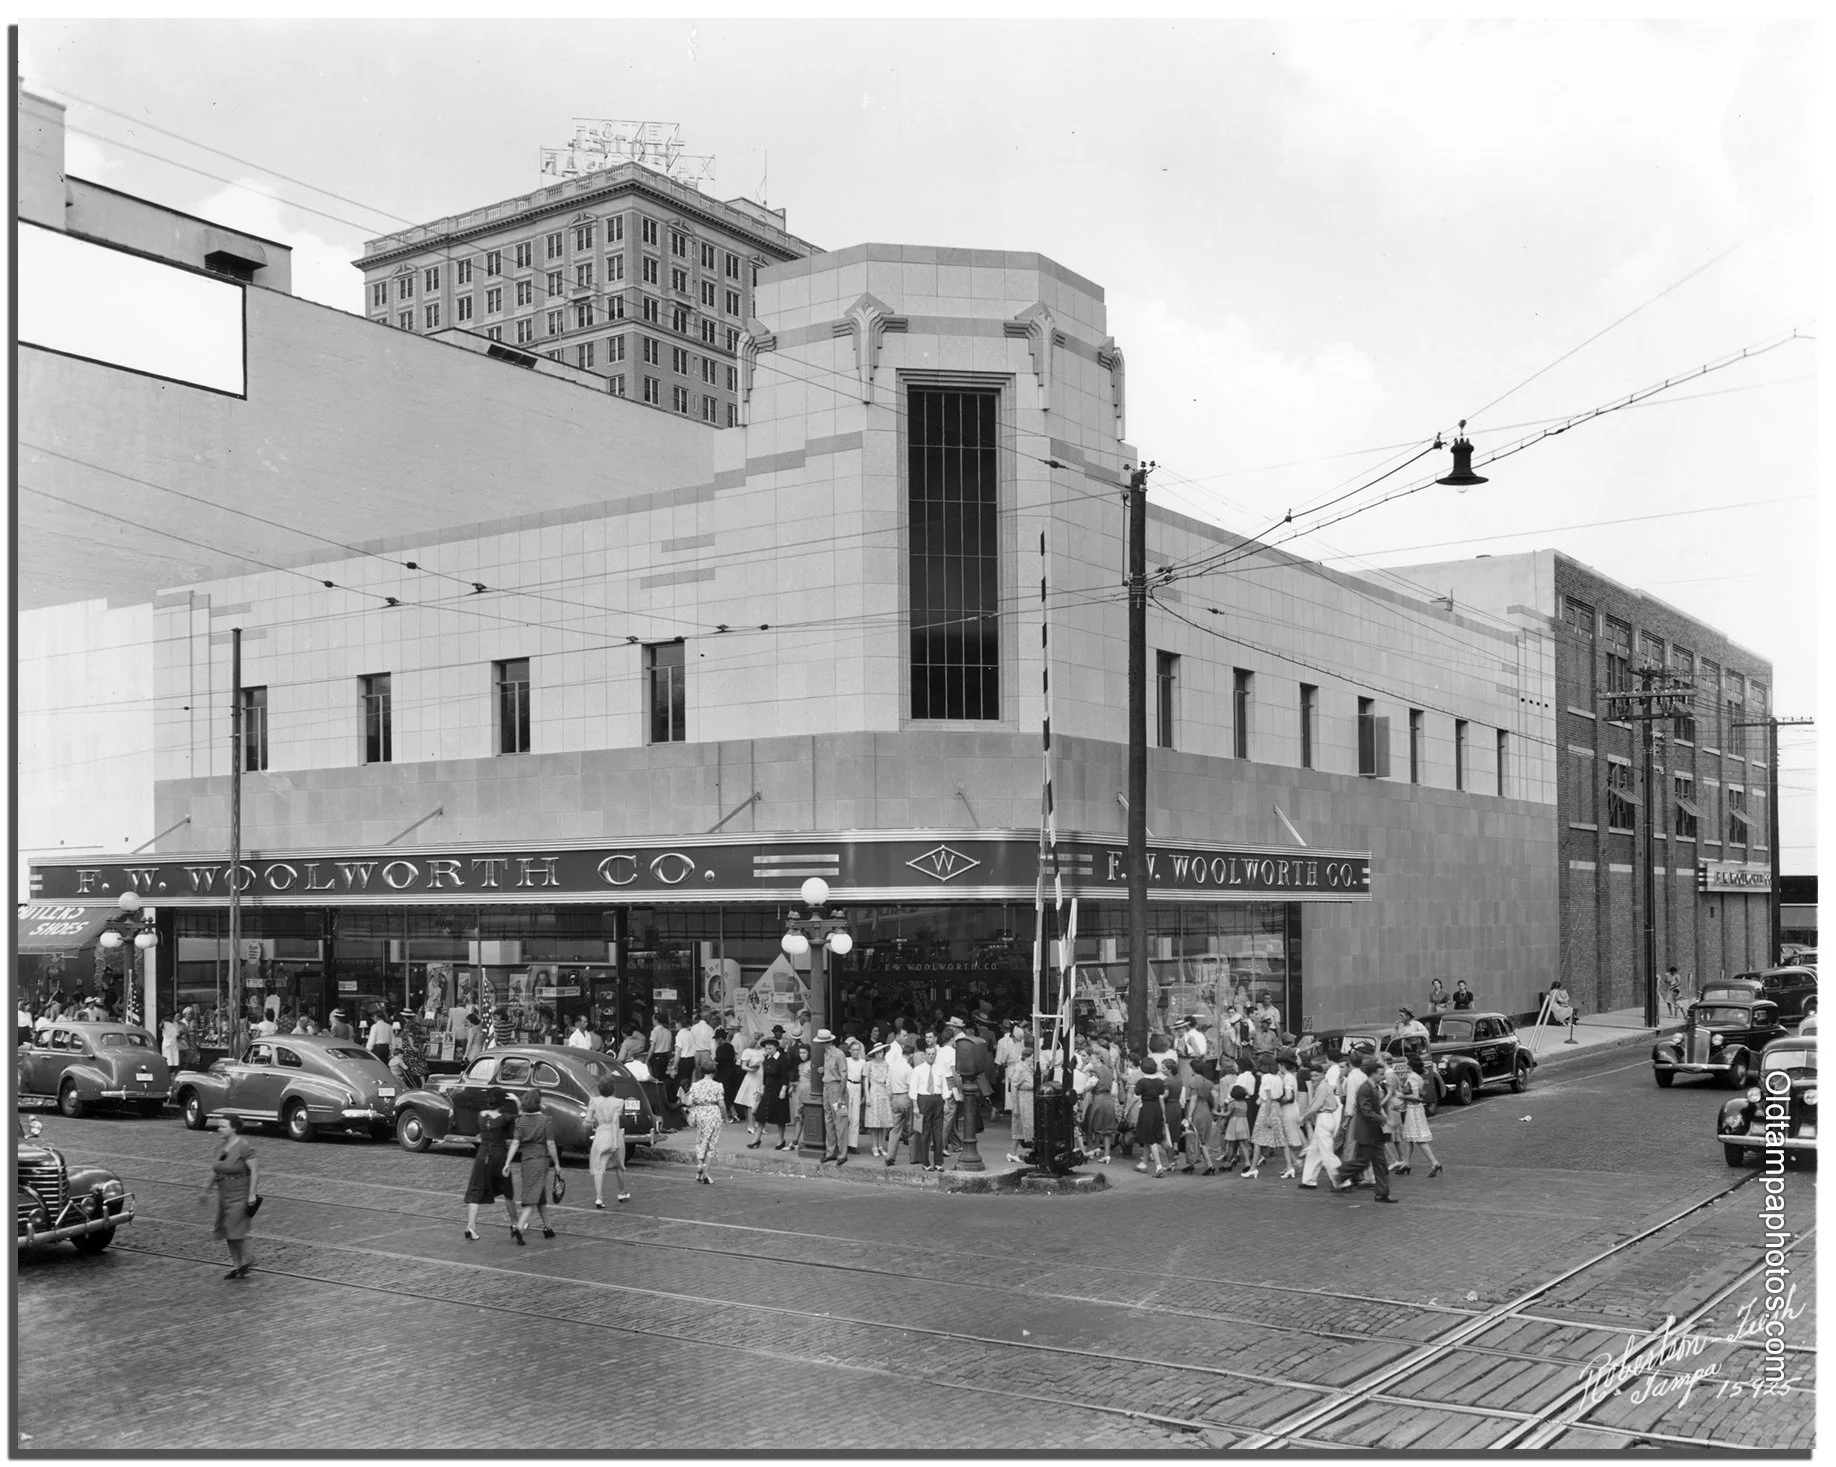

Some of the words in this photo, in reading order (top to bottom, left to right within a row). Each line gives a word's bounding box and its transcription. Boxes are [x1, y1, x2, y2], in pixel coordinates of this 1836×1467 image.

[76, 869, 110, 894] F.
[123, 867, 167, 893] W.
[183, 856, 560, 892] WOOLWORTH
[597, 852, 715, 886] CO.
[931, 851, 956, 875] W
[1107, 850, 1127, 881] F.
[1168, 854, 1319, 886] WOOLWORTH
[1326, 862, 1358, 888] CO.
[29, 921, 90, 936] SHOES
[1630, 1361, 1722, 1409] Tampa
